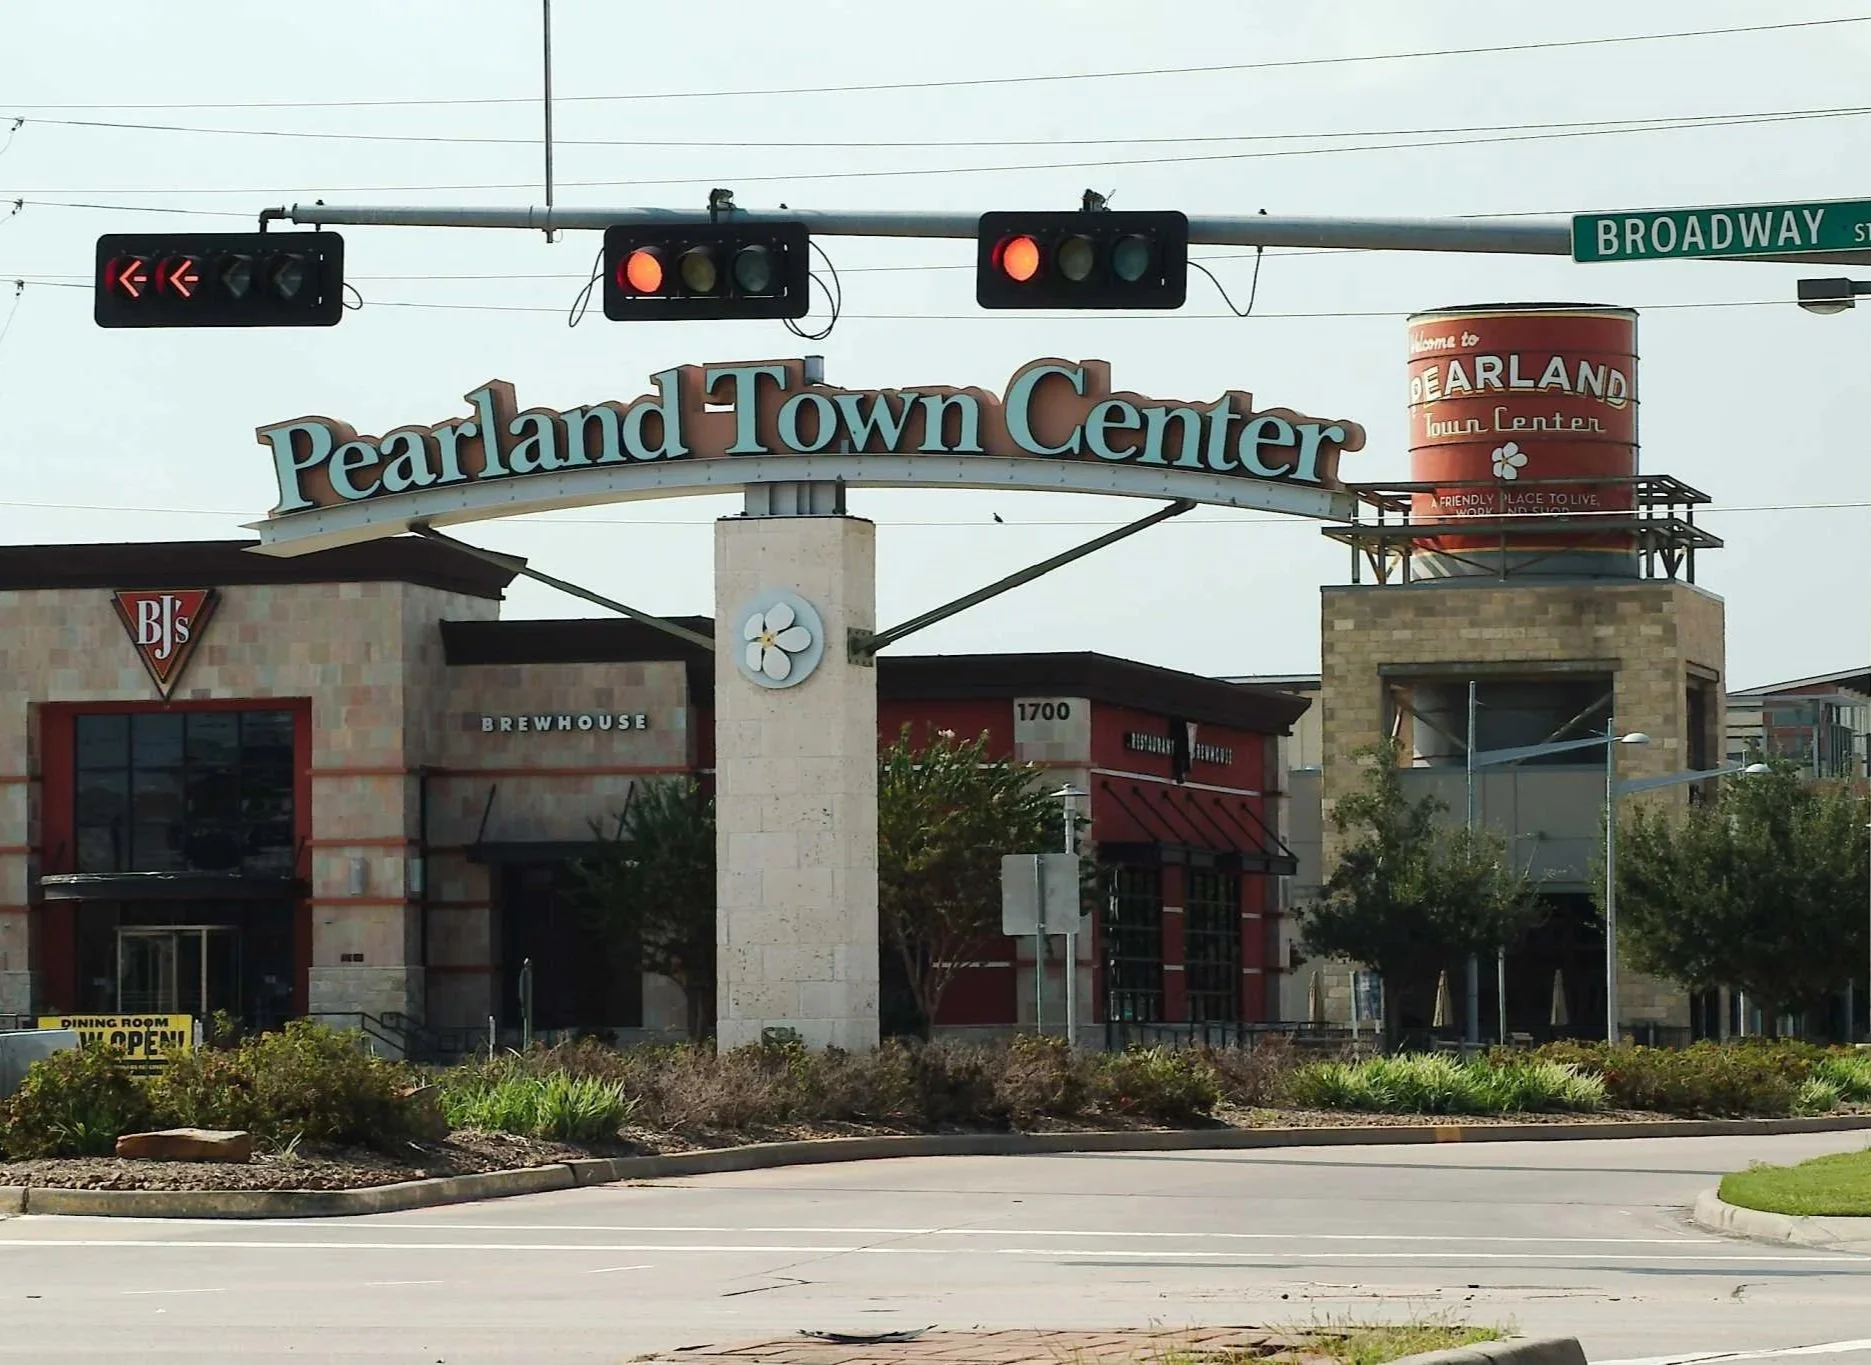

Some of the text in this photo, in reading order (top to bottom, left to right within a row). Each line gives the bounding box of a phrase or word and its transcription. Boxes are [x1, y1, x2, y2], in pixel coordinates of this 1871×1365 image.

[1597, 208, 1825, 256] BROADWAY
[1461, 330, 1480, 348] to
[1411, 353, 1629, 414] PEARLAND
[1423, 405, 1607, 438] Town Center
[263, 363, 1347, 515] Pearland Town Center
[1430, 498, 1438, 509] A
[1440, 493, 1495, 508] FRIENDLY
[1549, 493, 1568, 505] TO
[136, 595, 190, 660] BJ's
[481, 714, 647, 732] BREWHOUSE
[1017, 702, 1071, 722] 1700
[61, 1017, 169, 1028] DINING ROOM
